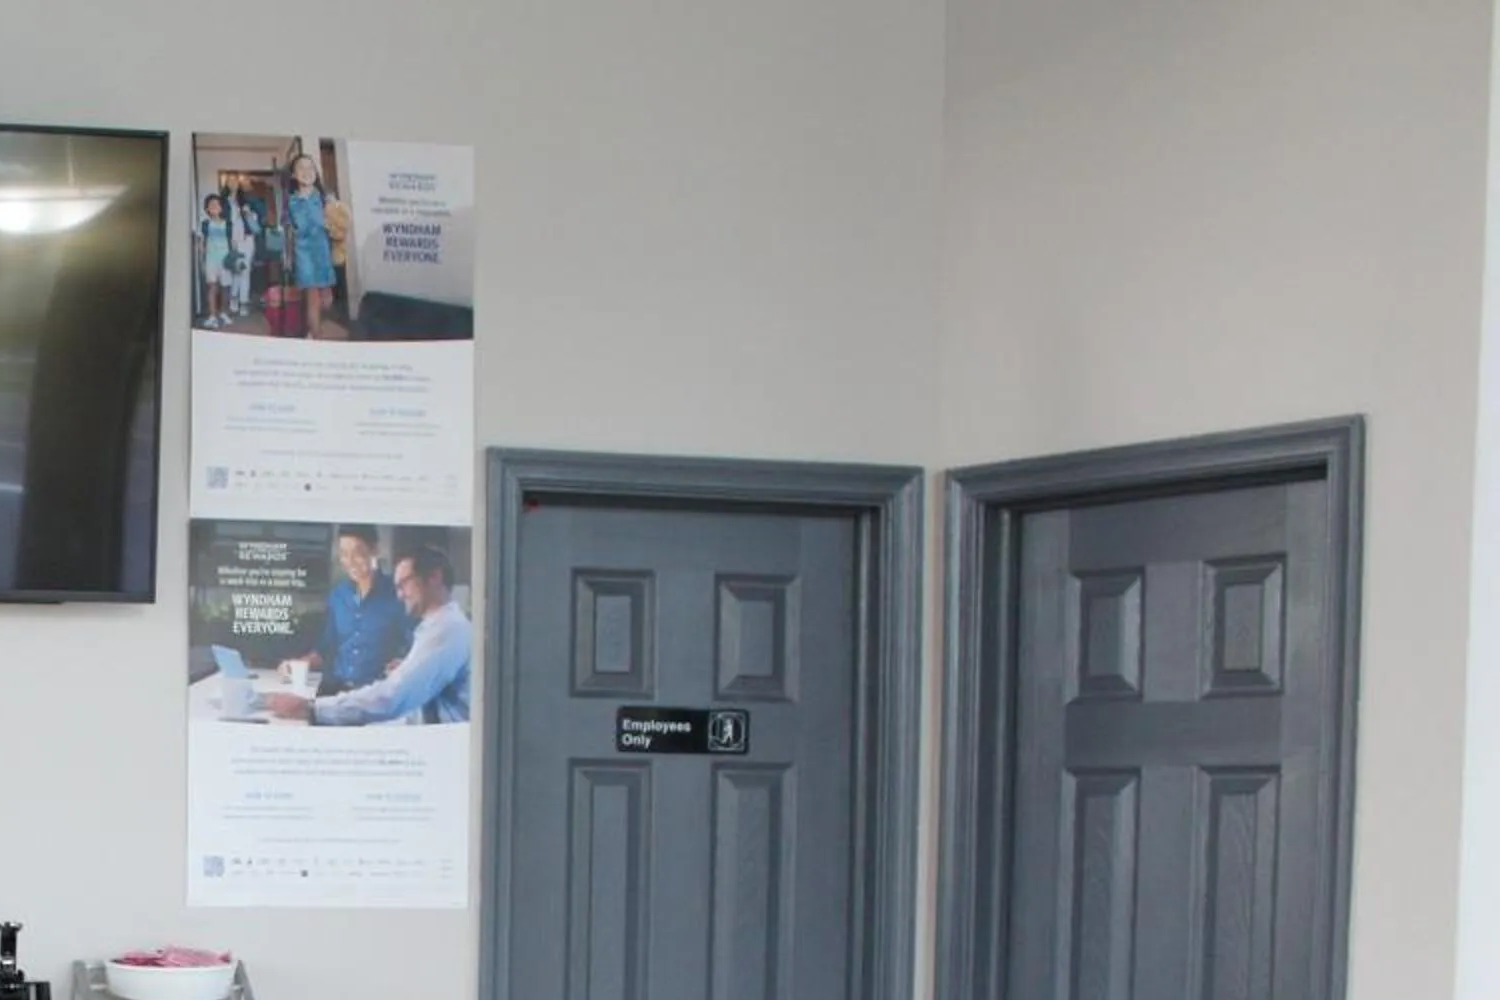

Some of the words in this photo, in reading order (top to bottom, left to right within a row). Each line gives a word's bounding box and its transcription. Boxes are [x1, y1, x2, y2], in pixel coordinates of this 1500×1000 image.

[382, 222, 442, 236] WYNDHAM
[385, 236, 439, 249] REWARDS
[231, 593, 293, 607] WYNDHAM
[235, 606, 289, 620] REWARDS
[622, 719, 692, 735] Employees
[621, 733, 652, 749] Only
